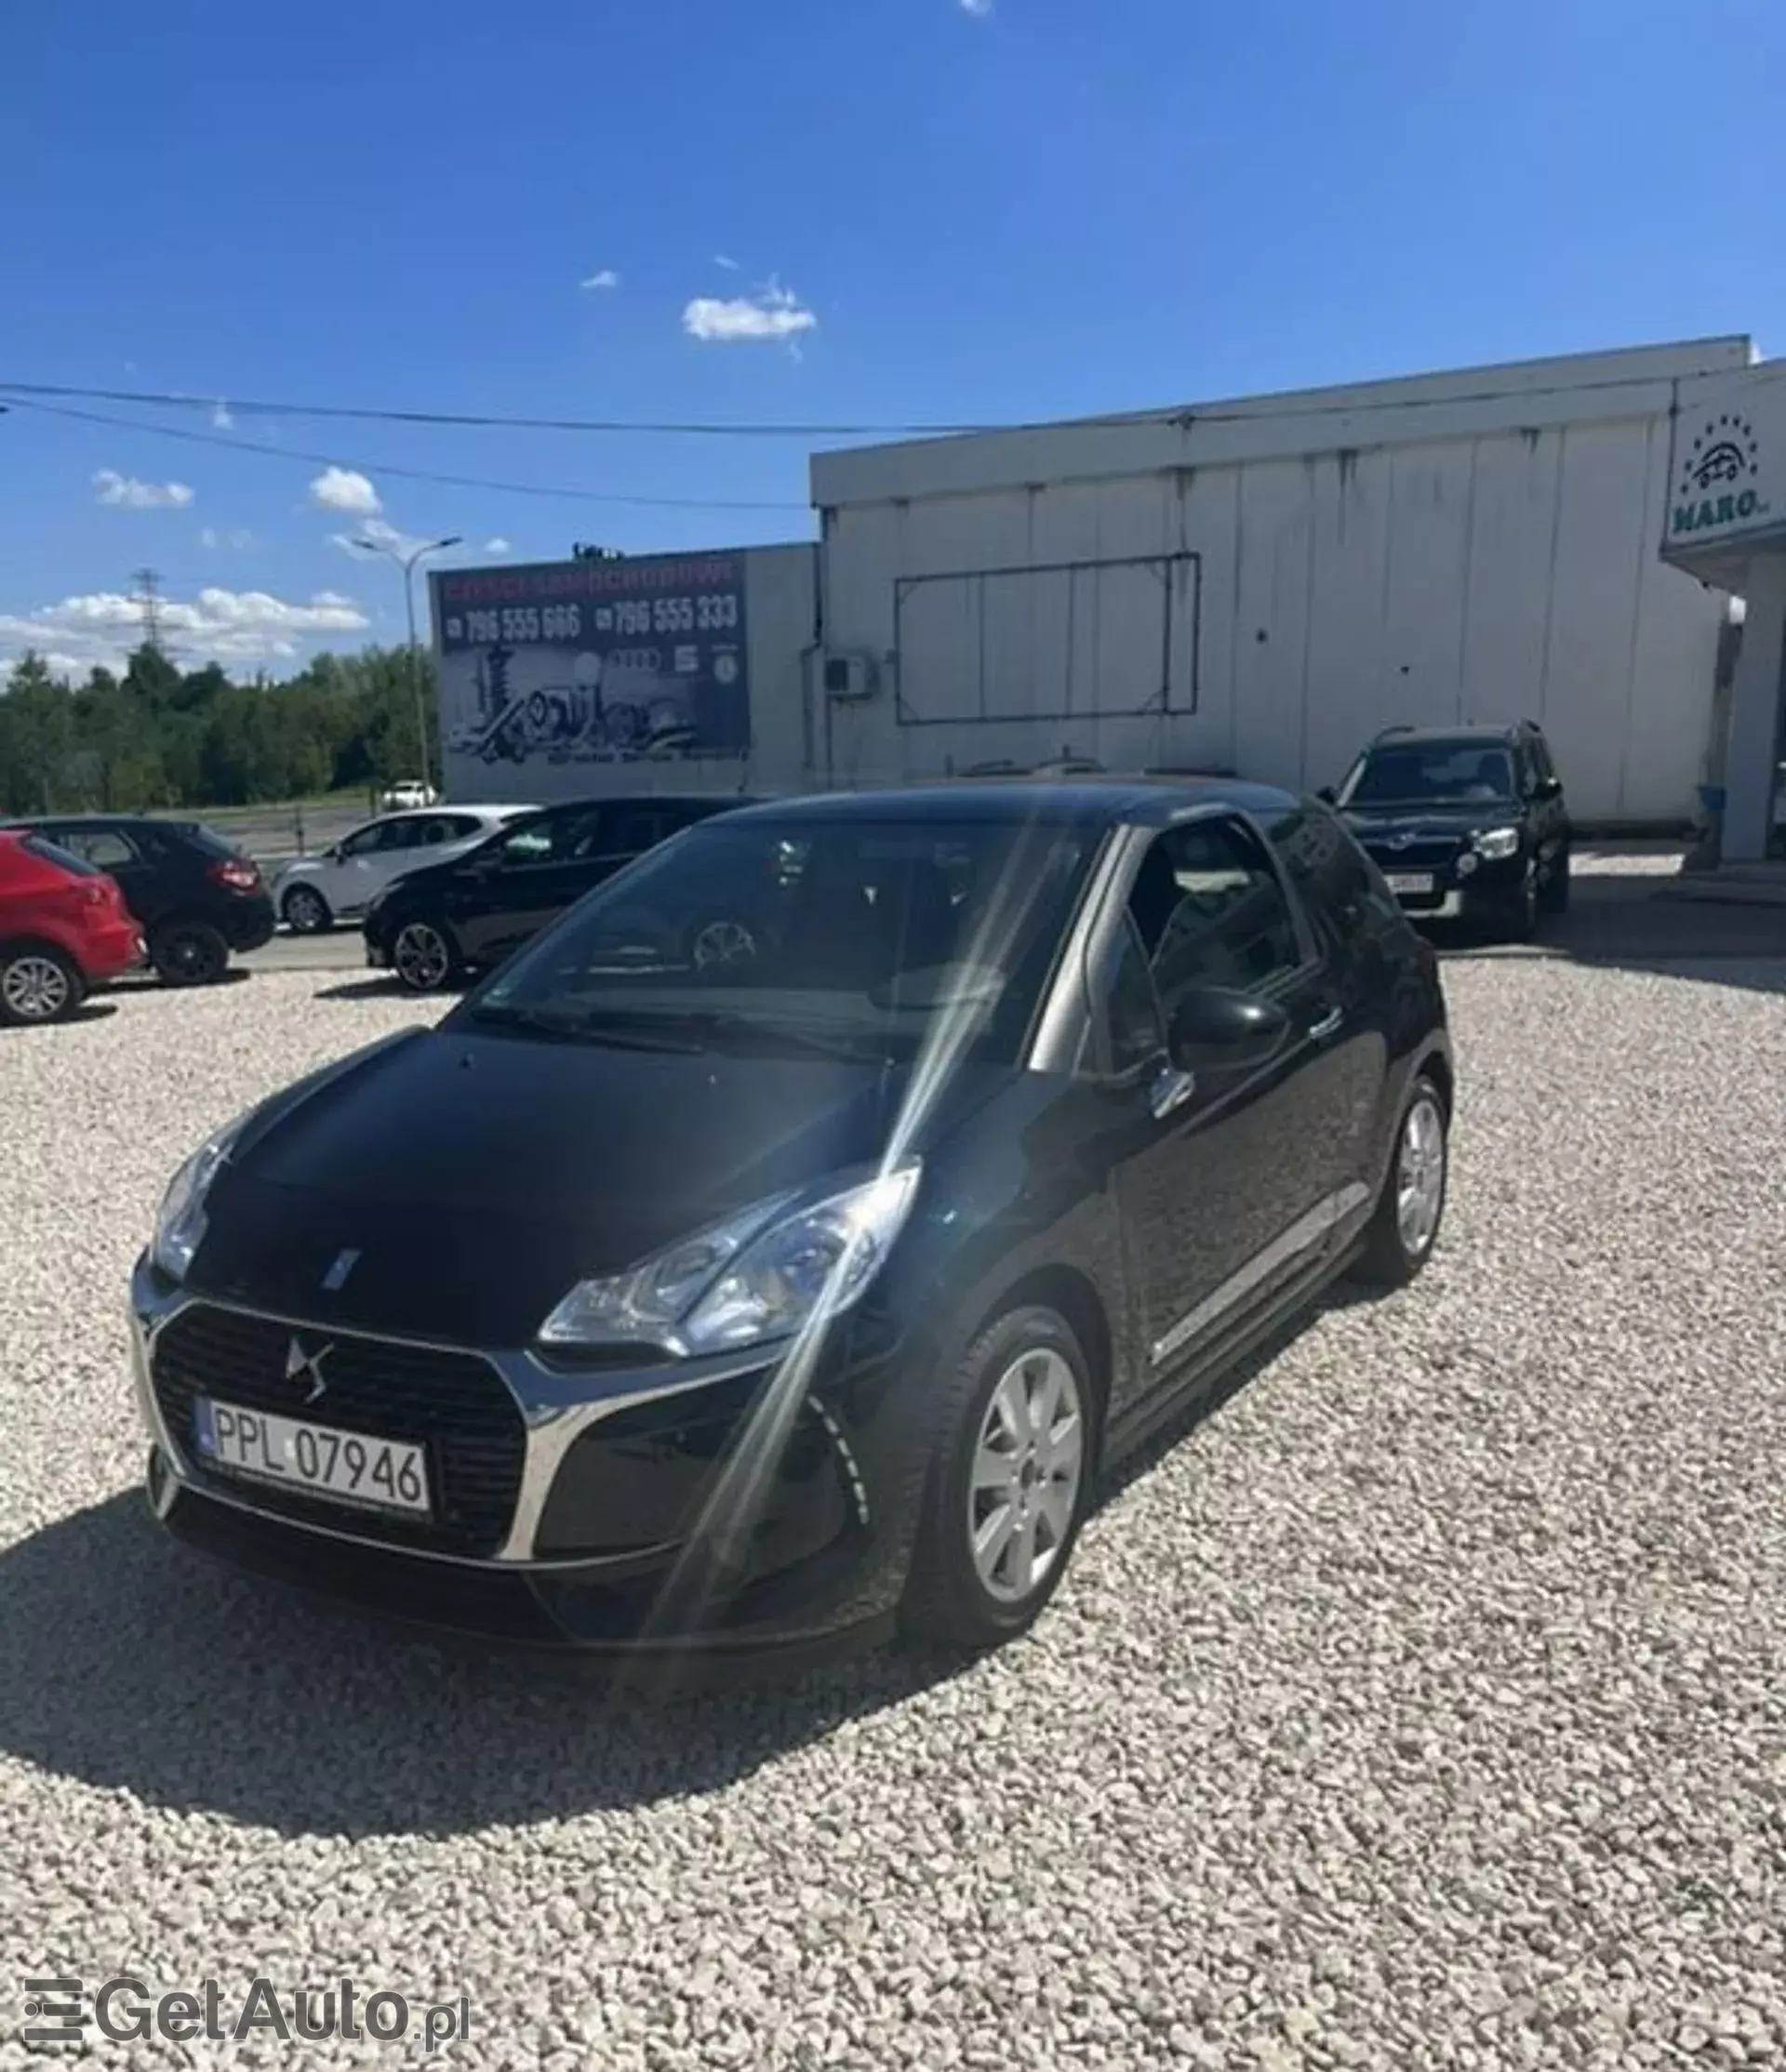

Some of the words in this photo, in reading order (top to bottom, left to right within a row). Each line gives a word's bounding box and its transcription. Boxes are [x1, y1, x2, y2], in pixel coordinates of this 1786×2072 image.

[1673, 489, 1756, 535] MARO
[467, 609, 499, 642] 796
[502, 606, 540, 640] 555
[616, 601, 650, 635] 796
[654, 597, 693, 631] 555
[697, 594, 738, 630] 333
[214, 1407, 285, 1472] PPL
[294, 1428, 421, 1503] 07946
